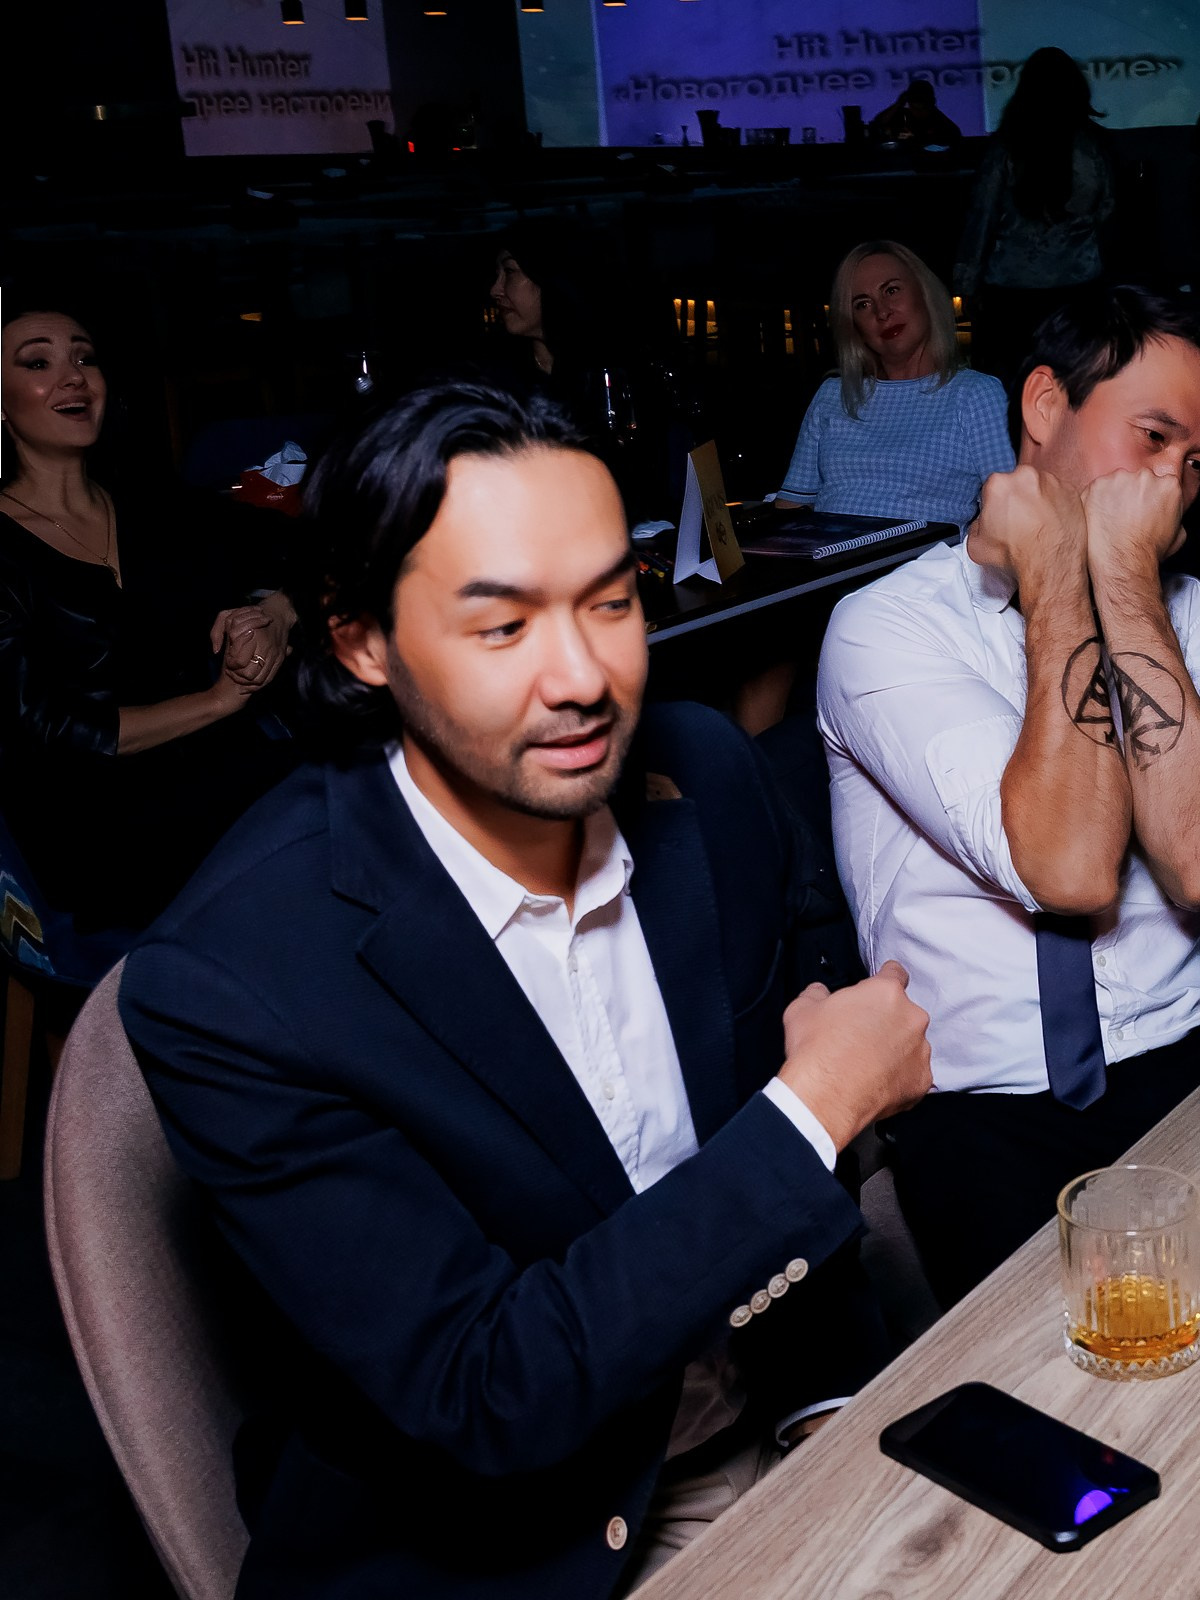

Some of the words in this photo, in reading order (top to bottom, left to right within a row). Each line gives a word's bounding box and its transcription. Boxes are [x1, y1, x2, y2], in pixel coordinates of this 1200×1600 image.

[775, 33, 826, 58] Hit
[842, 28, 981, 56] Hunter
[181, 47, 221, 78] Hit
[226, 47, 311, 79] Hunter
[612, 71, 873, 102] «Новогоднее
